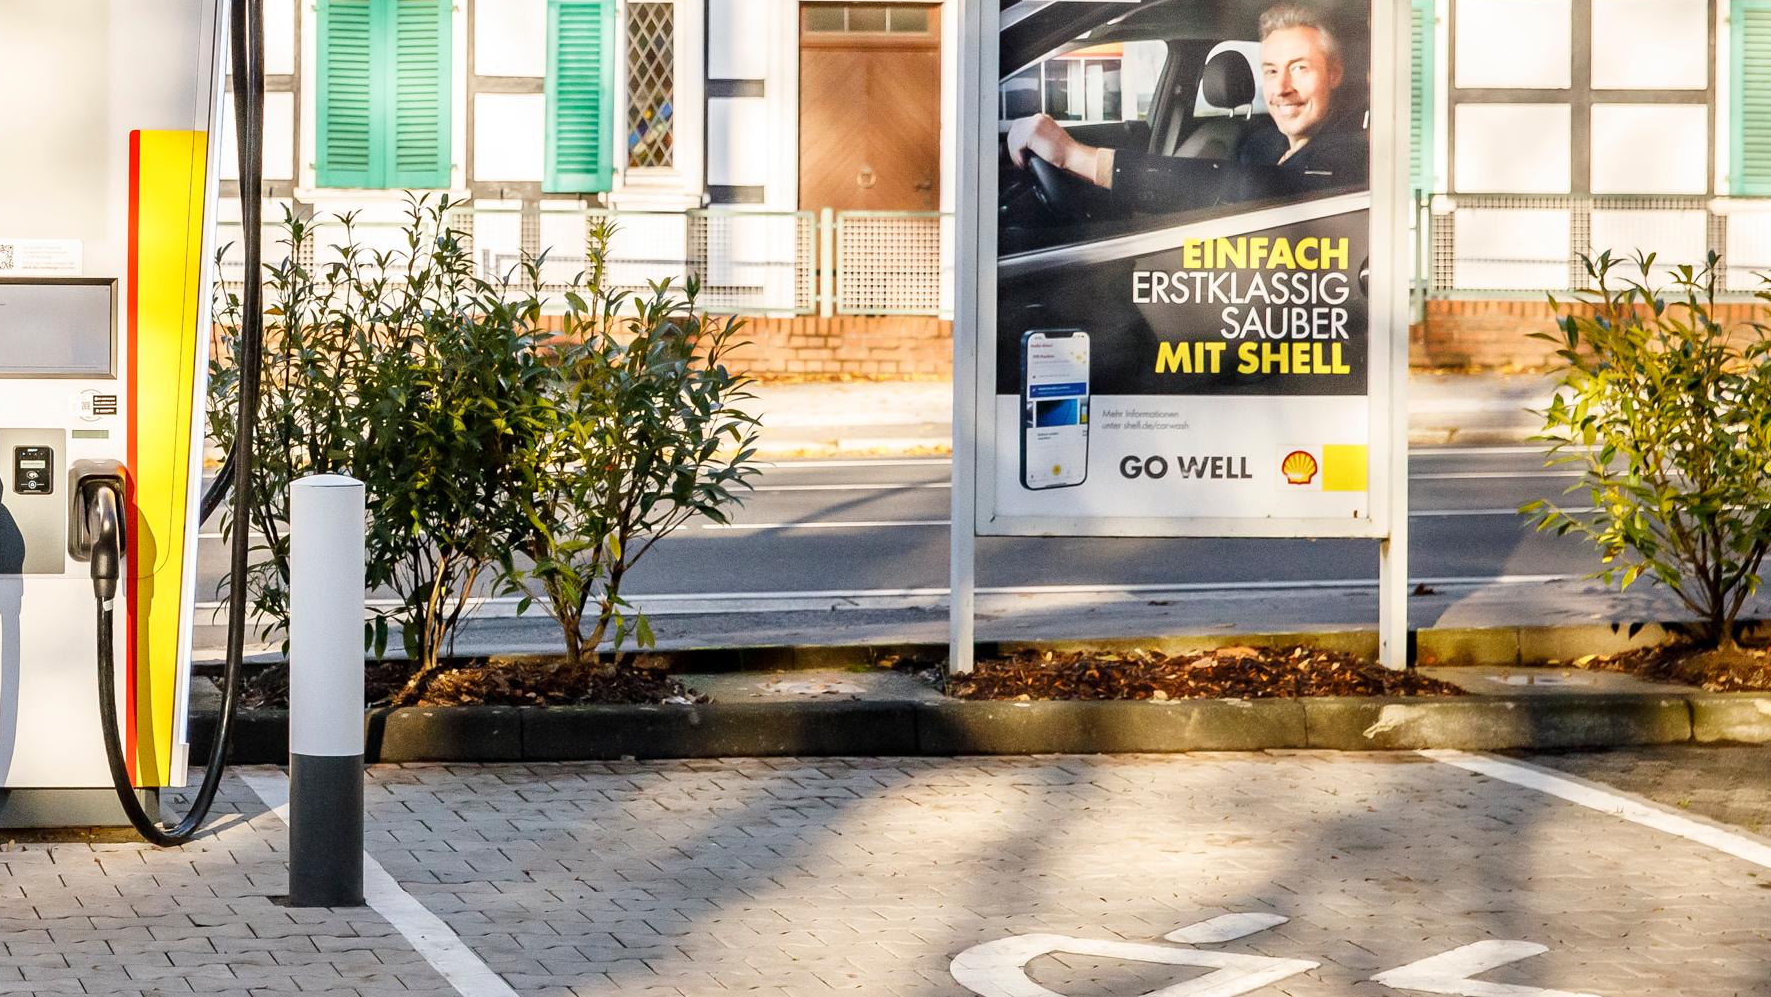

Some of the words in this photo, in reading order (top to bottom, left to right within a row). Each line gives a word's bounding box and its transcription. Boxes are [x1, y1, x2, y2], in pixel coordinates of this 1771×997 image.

[1183, 237, 1349, 270] EINFACH
[1132, 270, 1350, 305] ERSTKLASSIG
[1220, 306, 1349, 340] SAUBER
[1155, 342, 1227, 374] MIT
[1237, 342, 1351, 375] SHELL
[1101, 421, 1121, 429] unter
[1102, 408, 1123, 418] Mehr
[1125, 408, 1180, 418] Informationen
[1119, 454, 1168, 480] GO
[1177, 456, 1253, 479] WELL
